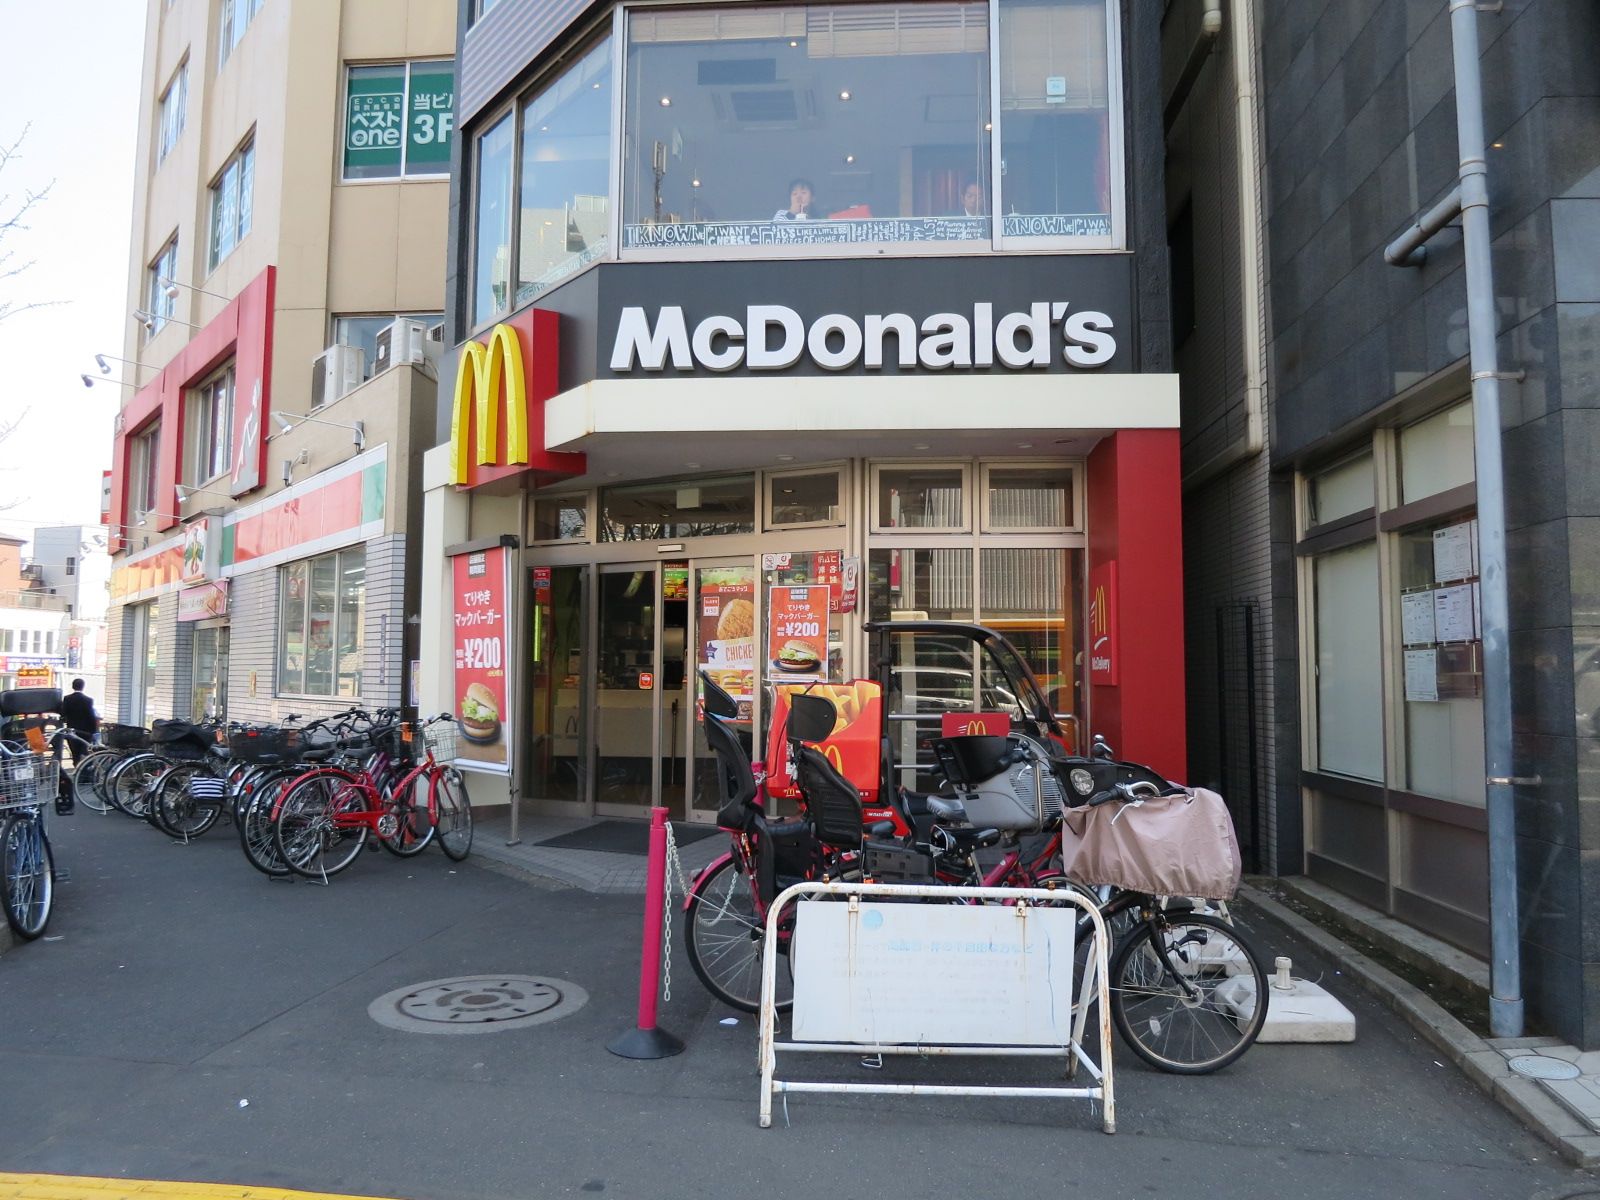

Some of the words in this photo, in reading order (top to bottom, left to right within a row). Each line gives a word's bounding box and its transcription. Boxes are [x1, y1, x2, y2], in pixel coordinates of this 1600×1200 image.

[352, 111, 400, 128] ベスト
[413, 113, 454, 144] 3F
[352, 128, 400, 146] one
[609, 301, 1117, 372] McDonald's
[464, 590, 491, 607] てりやき
[777, 612, 820, 621] マックバーガー
[787, 604, 810, 612] てりやき
[455, 609, 502, 627] マックバーガー
[786, 622, 819, 637] ¥200
[464, 636, 502, 669] ¥200
[726, 643, 754, 661] CHICKE
